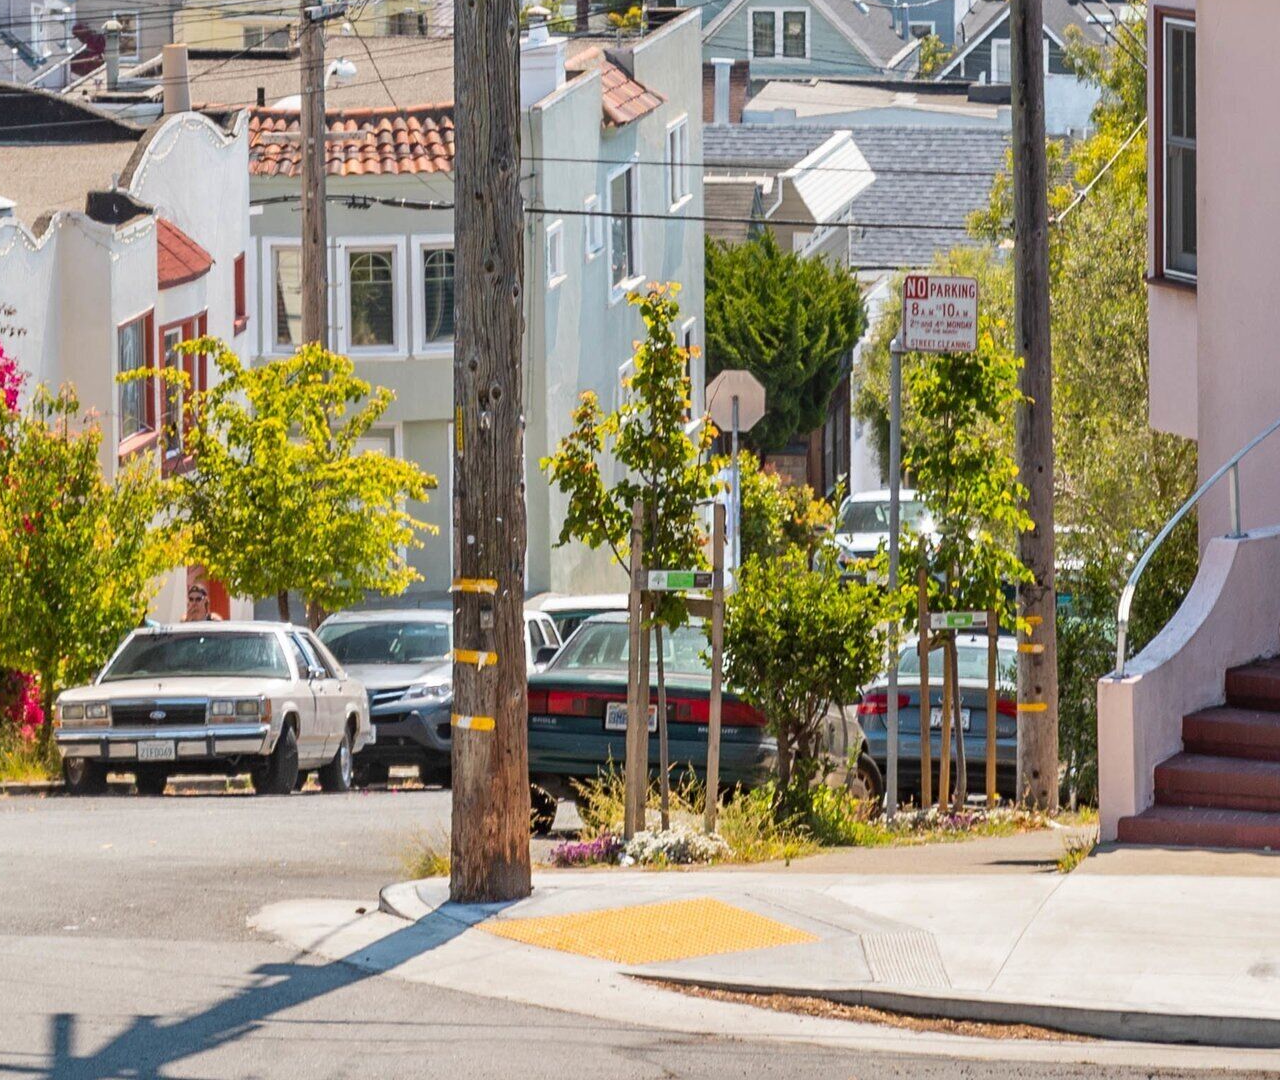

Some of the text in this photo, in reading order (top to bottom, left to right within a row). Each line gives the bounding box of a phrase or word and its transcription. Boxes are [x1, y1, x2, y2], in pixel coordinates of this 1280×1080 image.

[907, 278, 976, 298] NO PARKING
[910, 339, 971, 349] STREET CLEANING
